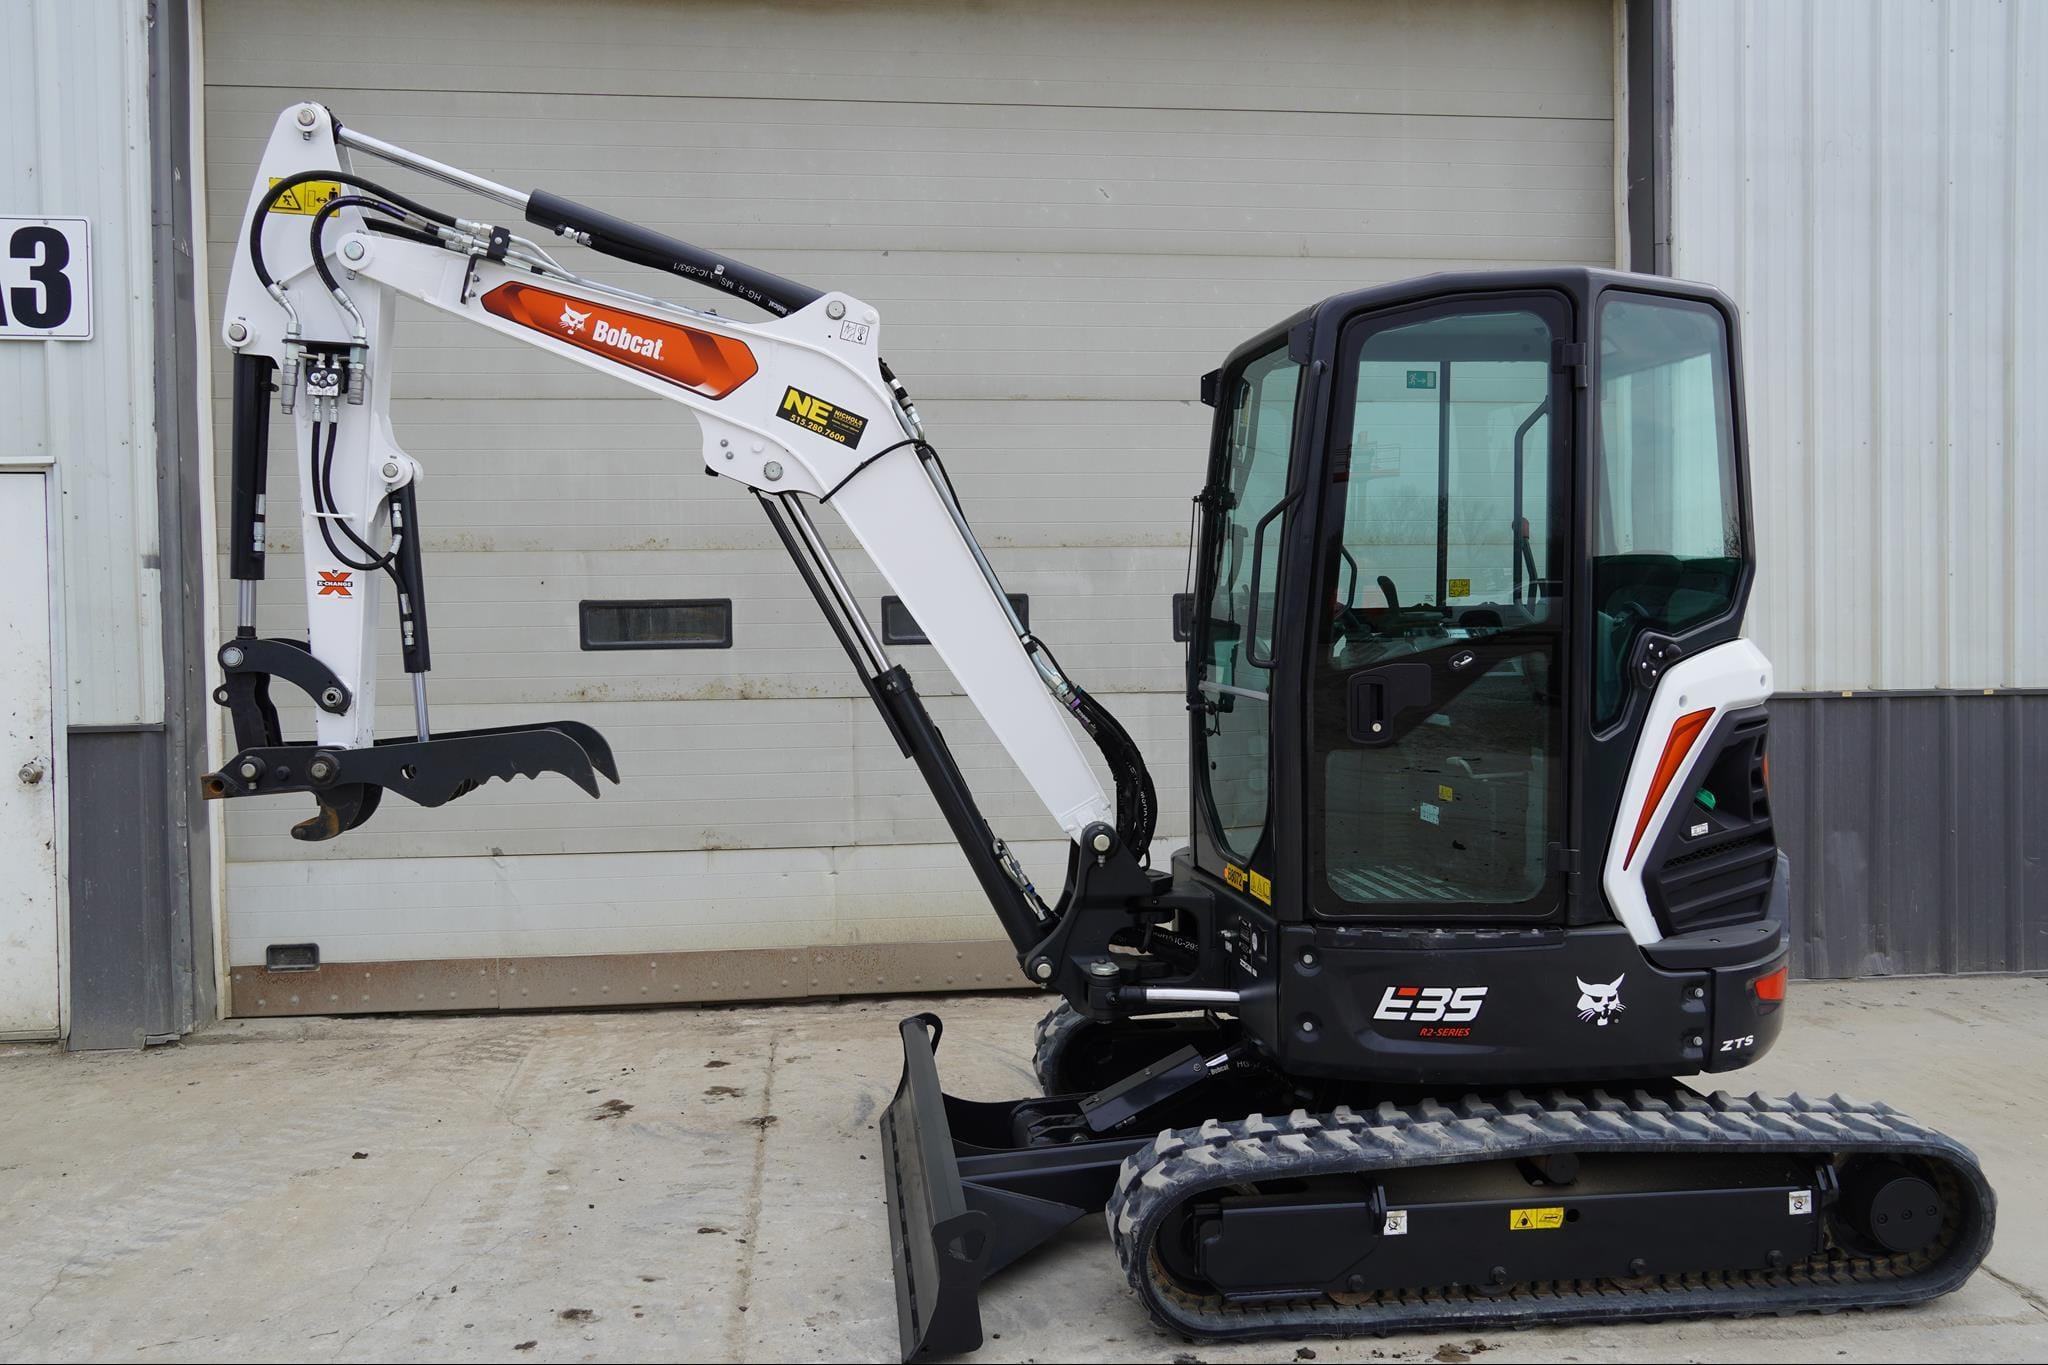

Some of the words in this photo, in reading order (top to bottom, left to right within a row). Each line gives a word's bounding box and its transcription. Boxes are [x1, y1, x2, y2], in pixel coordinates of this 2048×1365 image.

[0, 226, 72, 329] 3
[592, 319, 663, 360] Bobcat
[783, 388, 834, 426] NE
[833, 409, 863, 426] NICHOLS
[790, 414, 845, 442] 515.280.7600
[1373, 986, 1488, 1021] E35
[1419, 1028, 1470, 1037] R2-SERIES
[1720, 1035, 1754, 1051] ZTS
